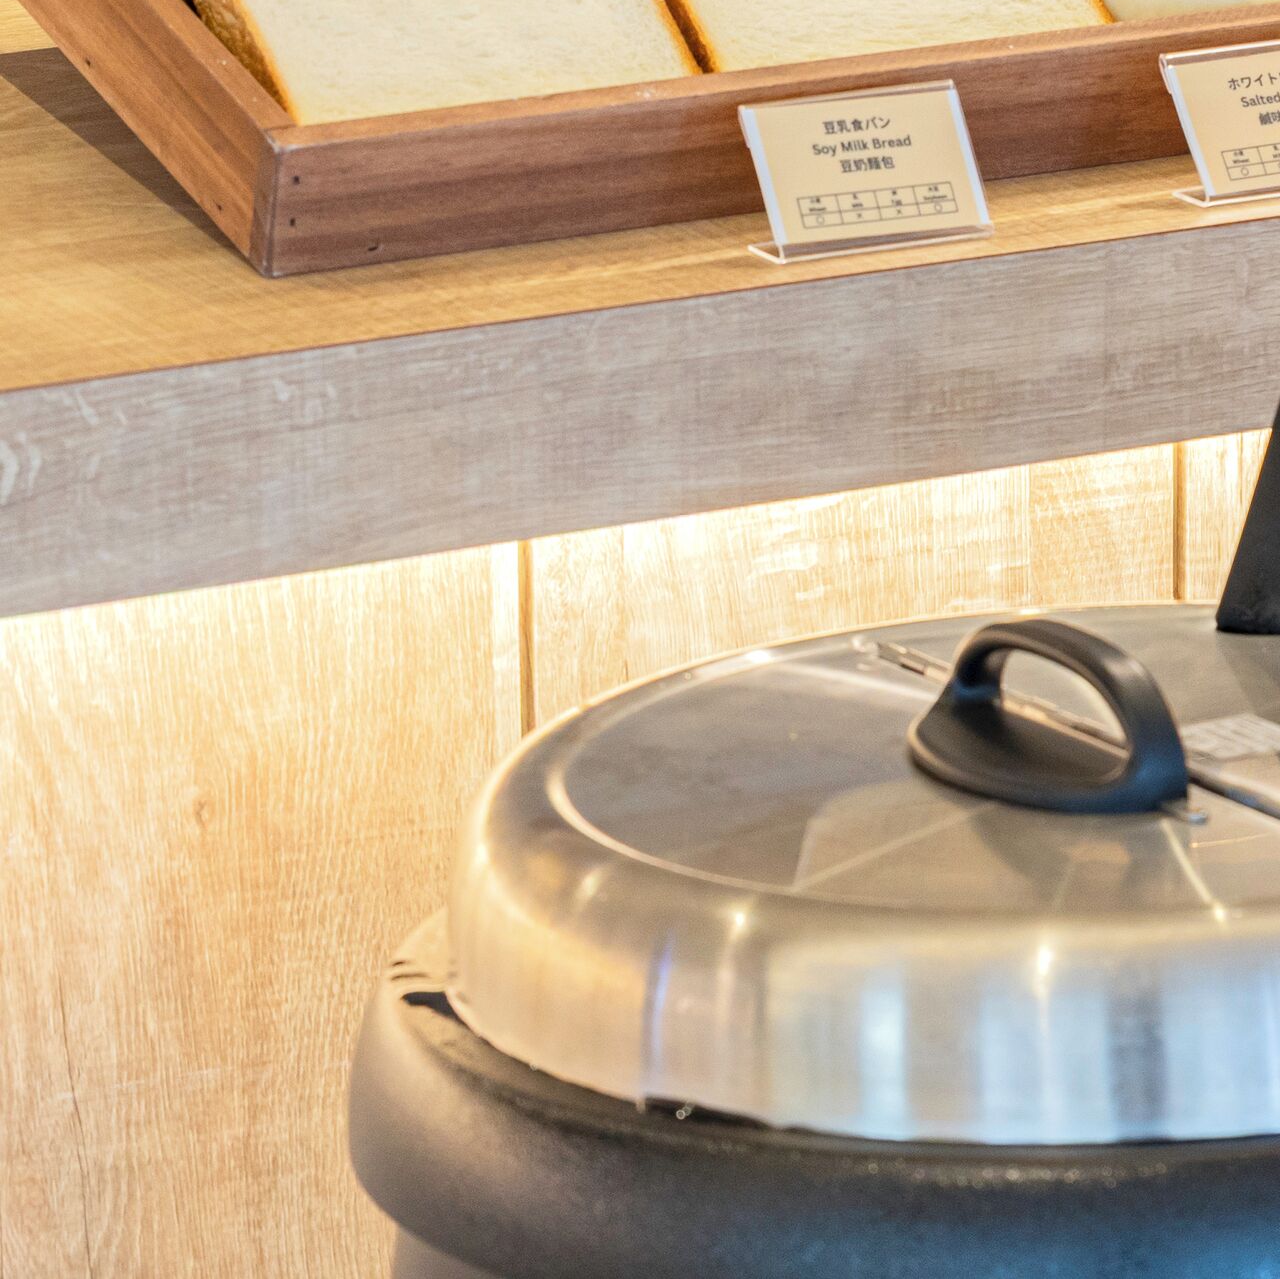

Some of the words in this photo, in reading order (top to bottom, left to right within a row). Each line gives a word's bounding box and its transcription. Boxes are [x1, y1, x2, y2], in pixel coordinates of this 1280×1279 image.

[822, 116, 891, 135] 豆乳食パン
[812, 142, 837, 157] Soy
[841, 139, 868, 153] Milk
[872, 135, 912, 150] Bread
